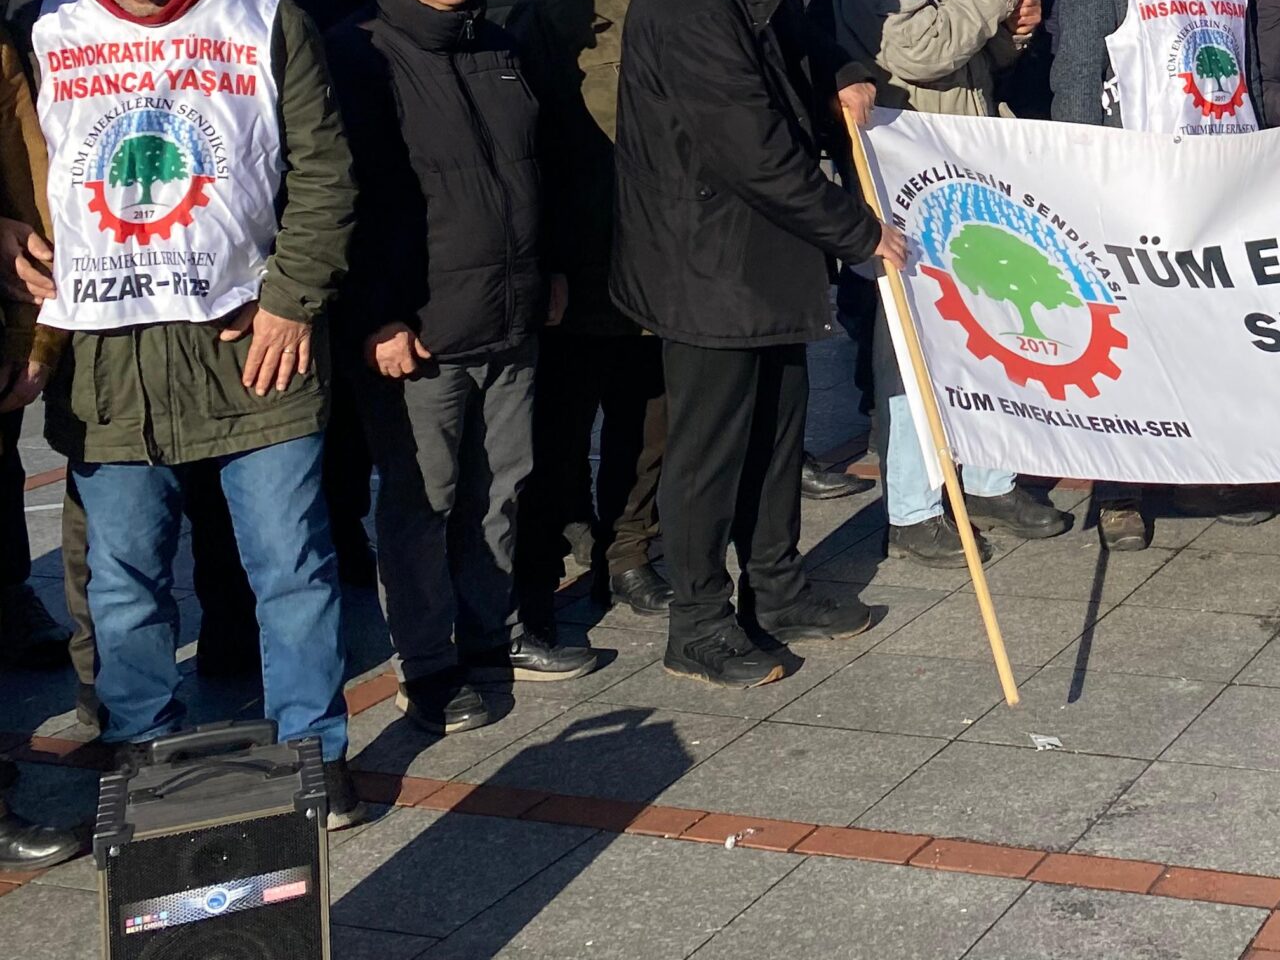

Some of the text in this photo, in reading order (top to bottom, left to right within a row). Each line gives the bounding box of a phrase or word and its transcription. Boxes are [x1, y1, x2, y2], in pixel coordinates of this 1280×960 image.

[1139, 1, 1208, 21] İNSANCA
[47, 33, 258, 73] DEMOKRATİK TÜRKİYE
[52, 68, 257, 103] İNSANCA YAŞAM
[71, 96, 229, 188] TÜM EMEKLİLERİN SENDİKASI
[895, 160, 1128, 302] EMEKLİLERİN SENDİKASI
[1103, 234, 1236, 290] TÜM
[1015, 336, 1060, 356] 2017
[944, 384, 1193, 439] TÜM EMEKLİLERİN-SEN
